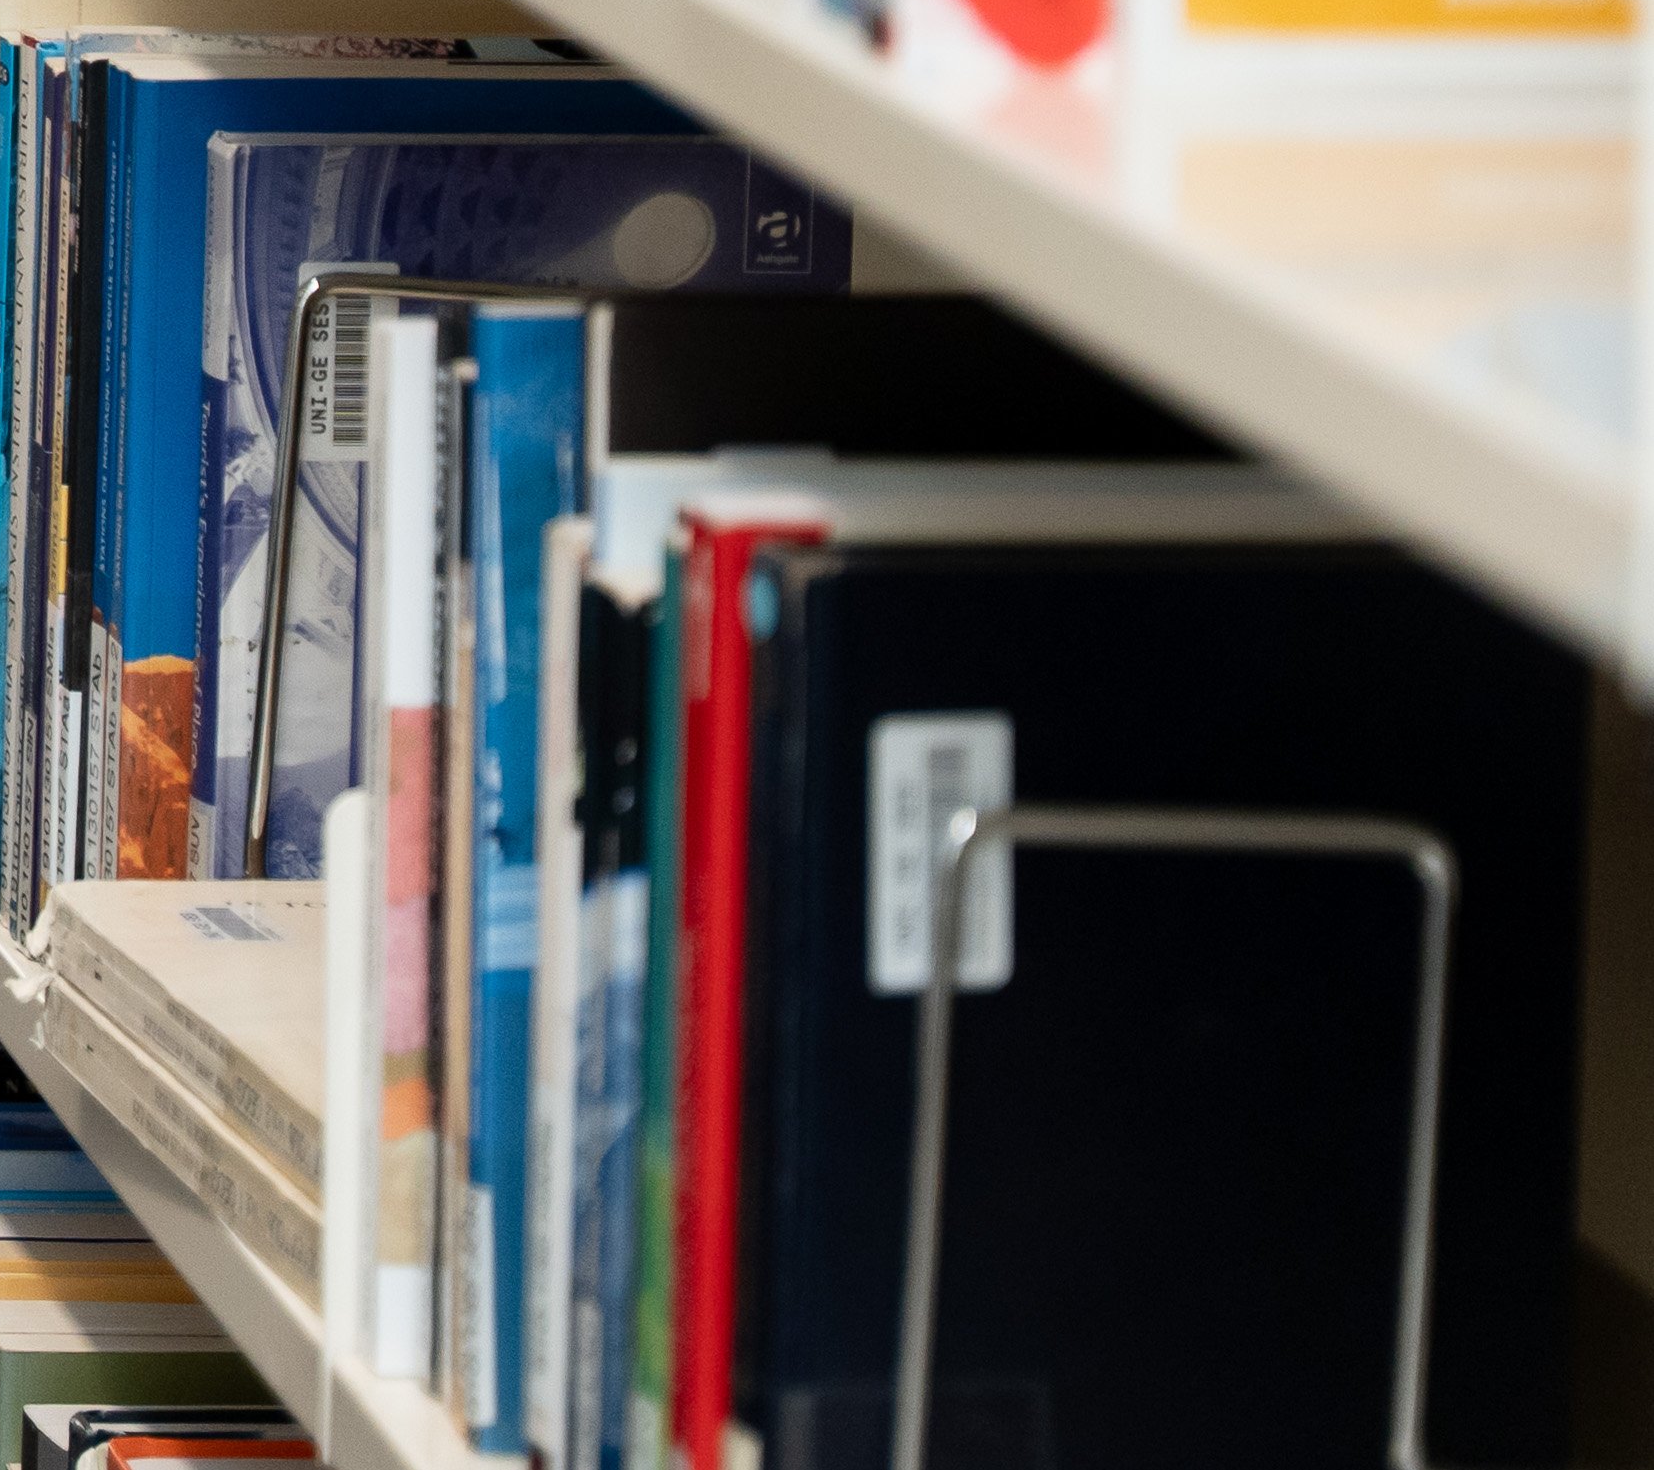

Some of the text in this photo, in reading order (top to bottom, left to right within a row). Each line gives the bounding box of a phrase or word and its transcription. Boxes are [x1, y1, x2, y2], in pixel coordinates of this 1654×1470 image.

[59, 189, 68, 256] ISSUES
[107, 151, 118, 270] GOUVERNANCE
[756, 253, 800, 265] Ashgate
[106, 274, 114, 331] QUELLE
[6, 73, 29, 632] TOURISM AND TOURISM SPACES
[54, 302, 65, 398] CULTURAL
[104, 335, 112, 373] VERS
[305, 301, 333, 434] UNI-GE SES
[51, 410, 62, 502] TOURISM
[48, 510, 59, 593] STUDIES
[98, 497, 108, 572] STATIONS
[189, 400, 211, 770] Tourist's Experience of Place
[58, 693, 71, 770] STAa
[89, 652, 103, 734] STAb
[25, 715, 34, 764] SIN
[106, 710, 118, 788] STAb
[41, 704, 54, 869] 910.130157
